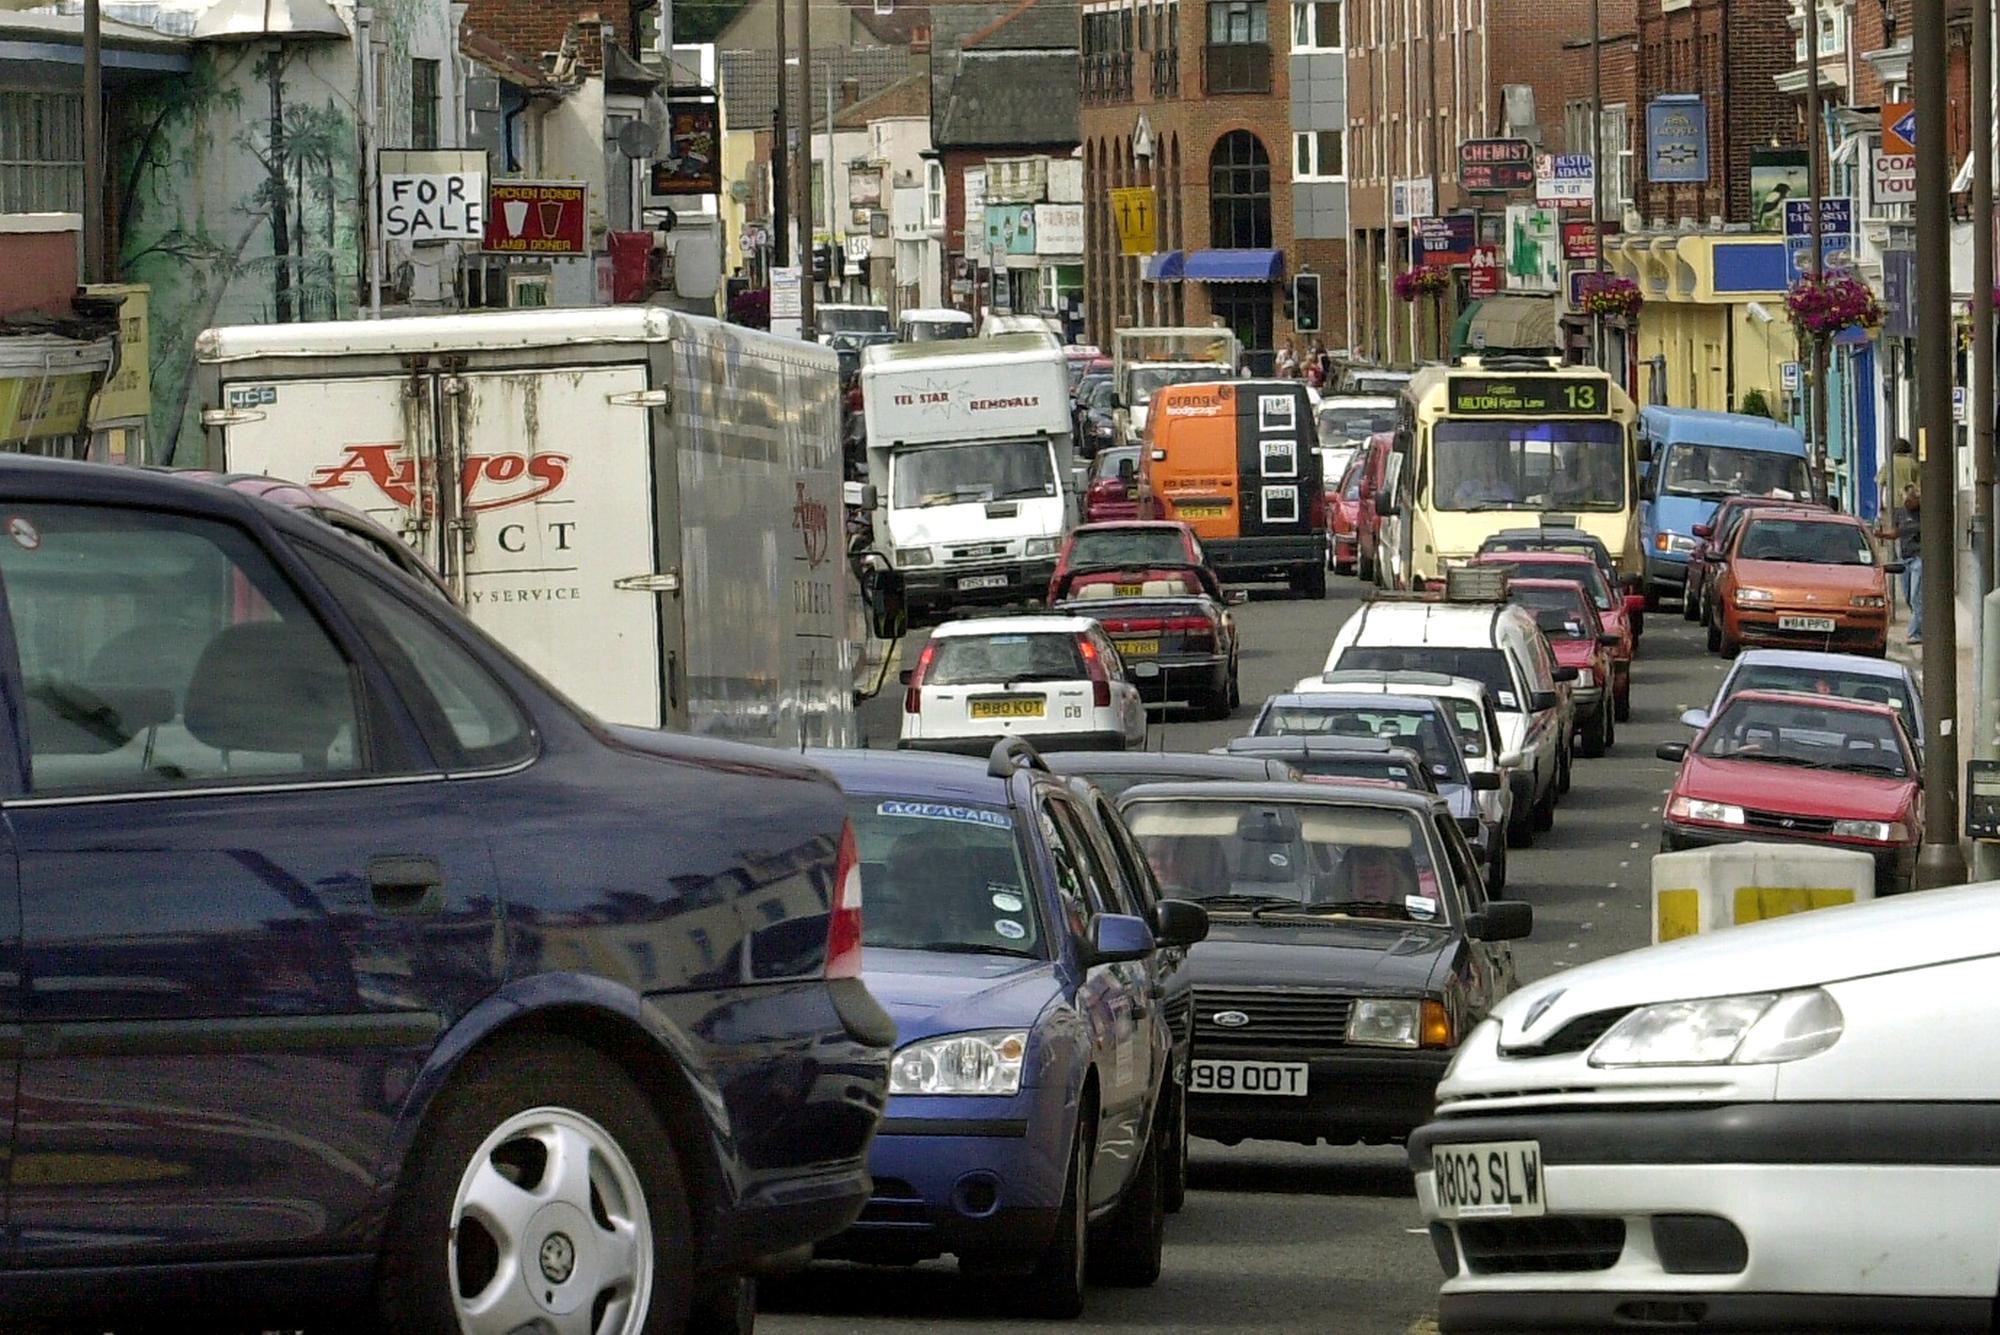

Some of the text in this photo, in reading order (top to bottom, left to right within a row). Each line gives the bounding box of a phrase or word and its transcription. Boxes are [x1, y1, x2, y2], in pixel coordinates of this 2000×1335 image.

[1461, 143, 1529, 161] CHEMIST
[1876, 158, 1916, 172] COA
[392, 176, 465, 205] FOR
[1877, 179, 1916, 194] TOU
[1797, 202, 1841, 212] INIAN
[386, 202, 480, 237] SALE
[1803, 222, 1836, 232] FOD
[919, 392, 950, 404] STAR
[969, 396, 1039, 412] REMOVALS
[1167, 395, 1222, 407] orange
[1564, 385, 1596, 409] 13
[308, 442, 573, 515] Argos
[490, 587, 581, 602] SERVICE
[1064, 705, 1082, 718] GB
[1188, 1064, 1236, 1090] 98
[1435, 1150, 1539, 1208] R803 SLW
